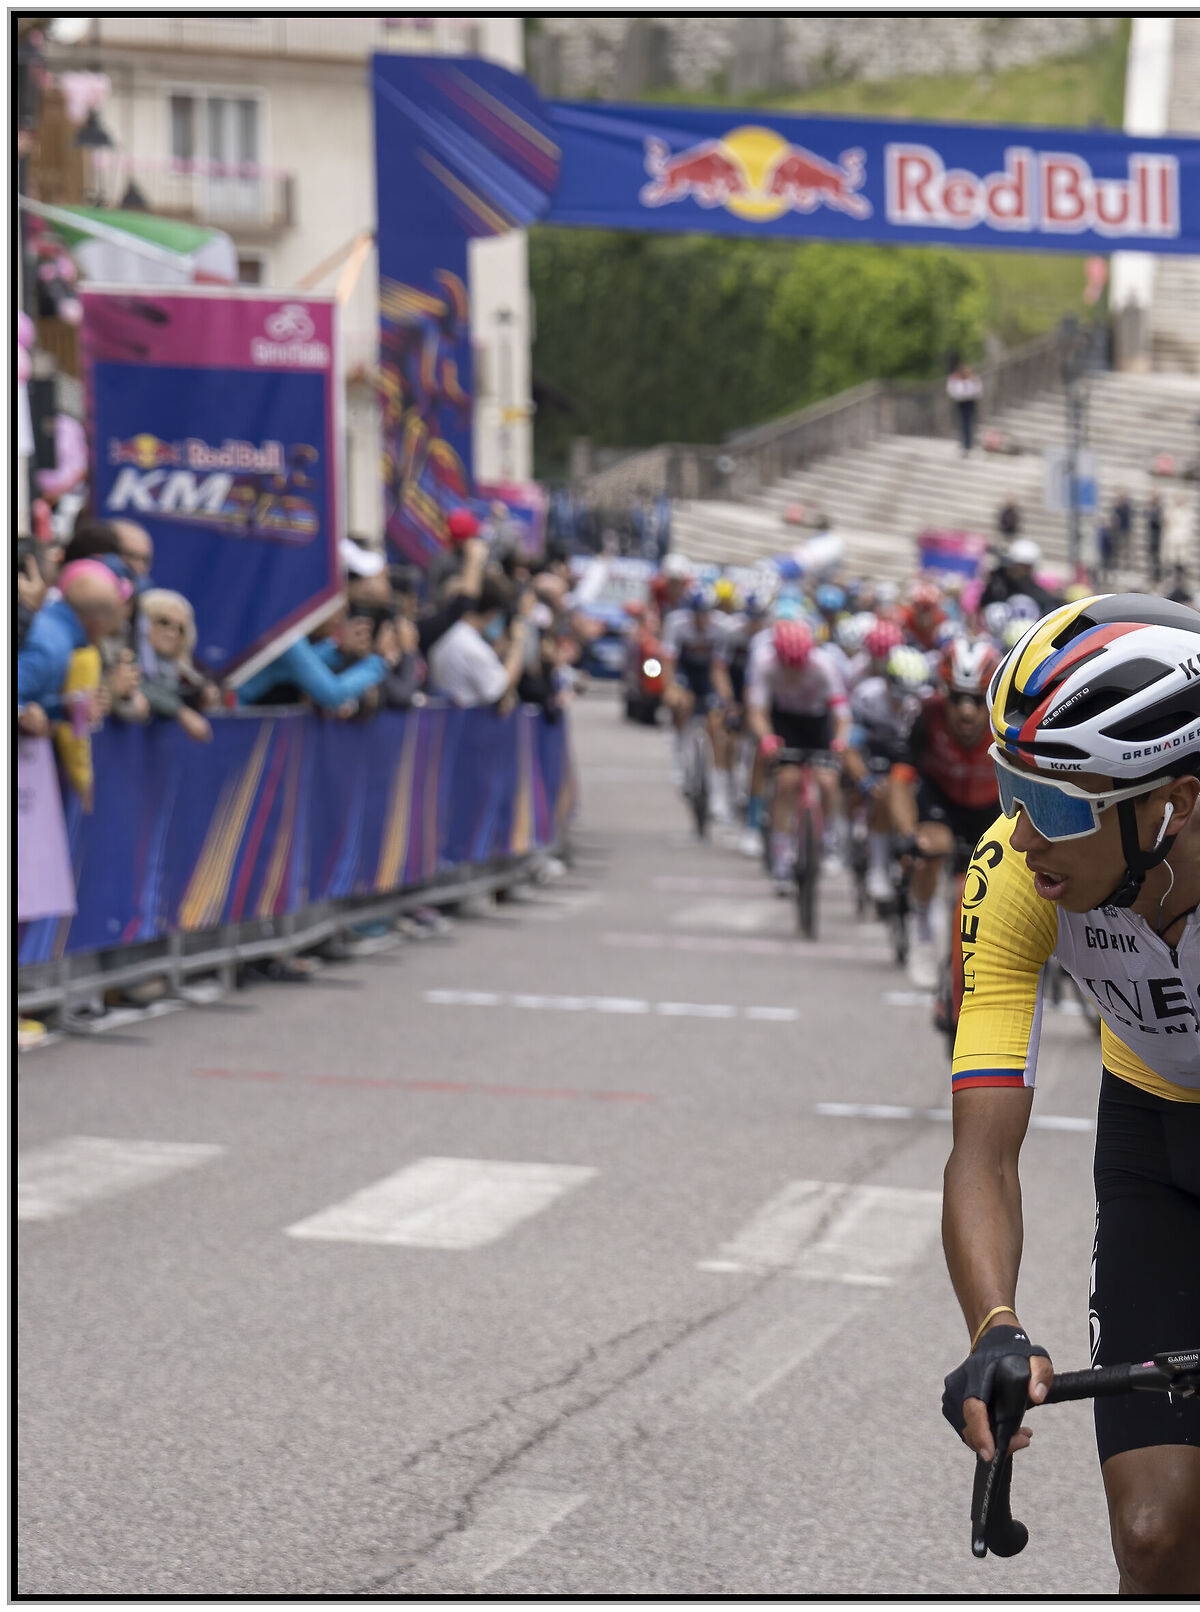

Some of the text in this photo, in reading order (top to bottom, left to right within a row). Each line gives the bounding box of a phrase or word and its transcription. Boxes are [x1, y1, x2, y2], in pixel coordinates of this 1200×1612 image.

[888, 145, 1179, 237] Red Bull
[106, 467, 232, 513] KM
[1050, 762, 1081, 770] KASK
[1085, 925, 1140, 953] GOBIK
[1168, 1353, 1199, 1363] GARMIN
